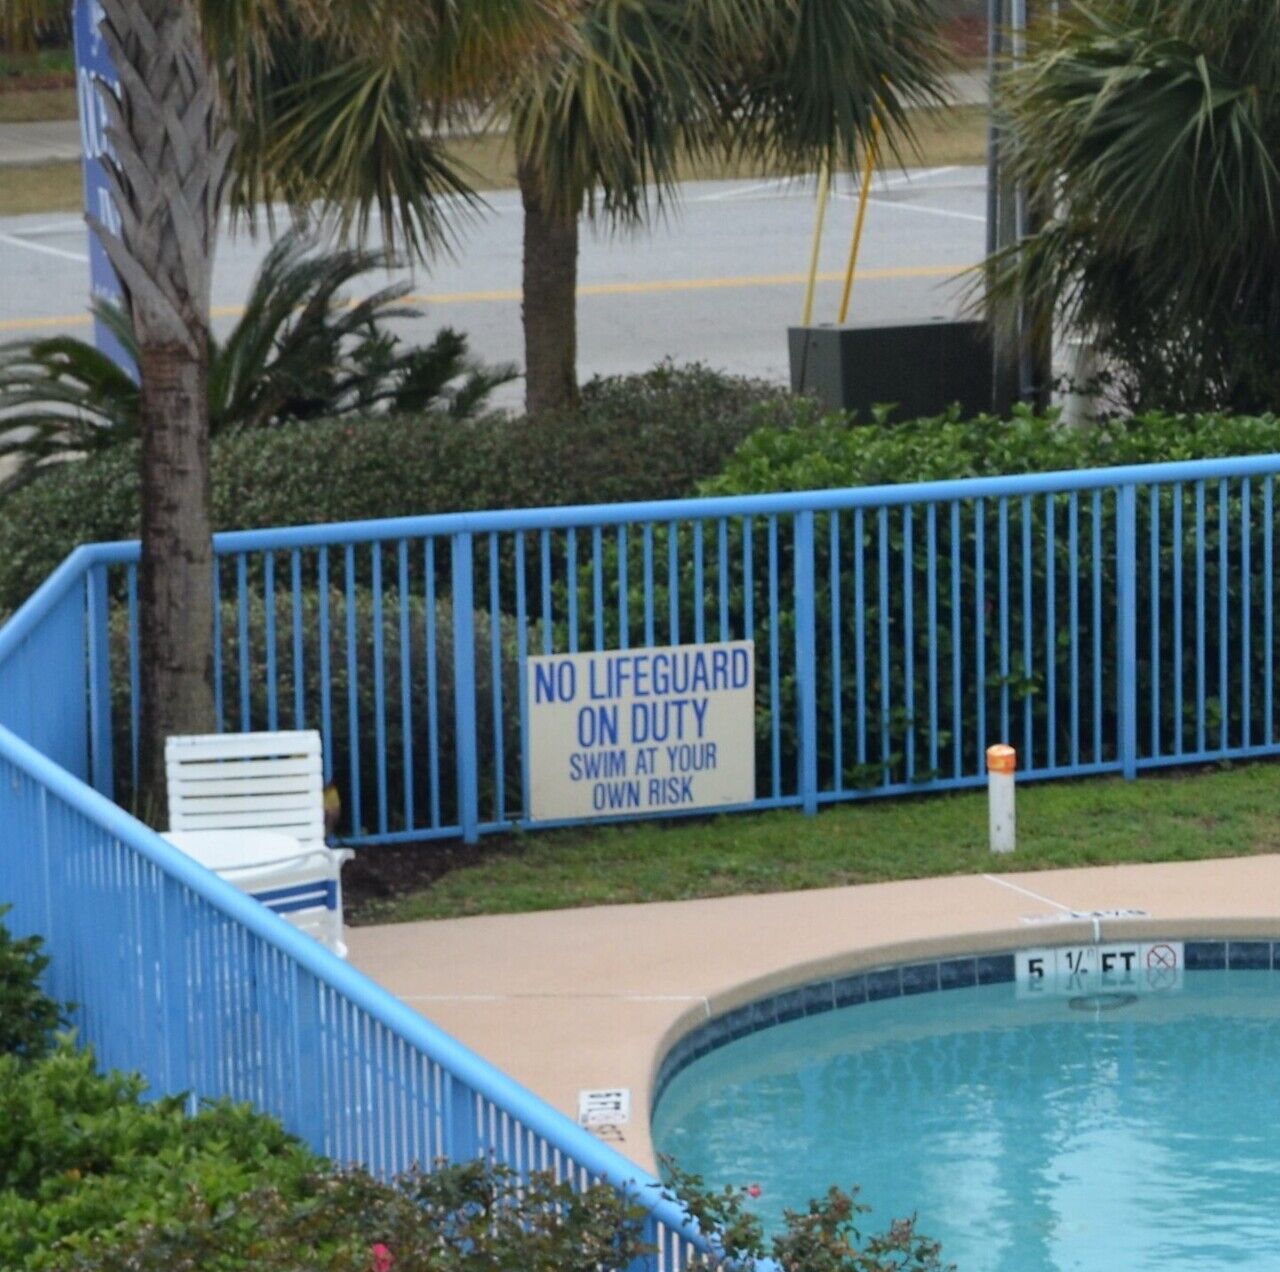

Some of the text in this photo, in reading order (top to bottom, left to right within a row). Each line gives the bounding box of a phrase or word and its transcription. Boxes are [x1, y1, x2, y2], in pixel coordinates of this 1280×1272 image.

[534, 648, 749, 704] NO LIFEGUARD
[577, 698, 709, 748] ON DUTY
[569, 742, 717, 781] SWIM AT YOUR
[593, 776, 694, 811] OWN RISK
